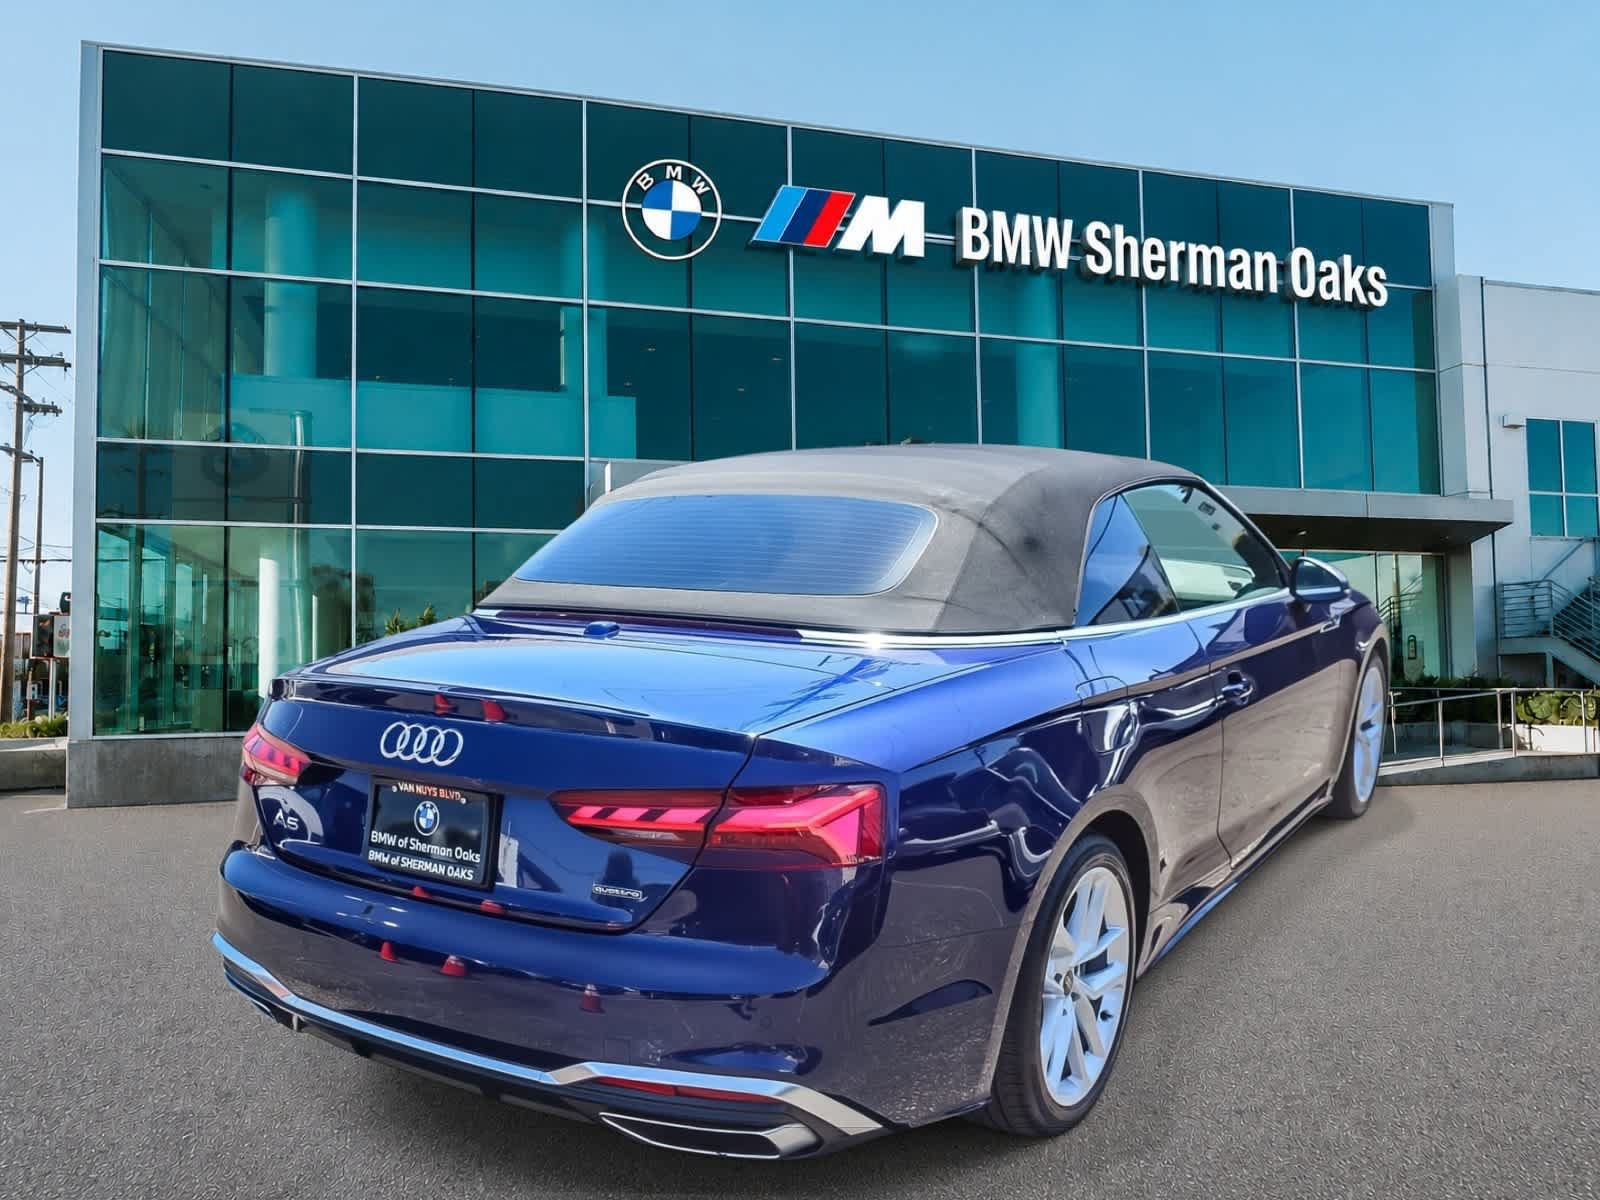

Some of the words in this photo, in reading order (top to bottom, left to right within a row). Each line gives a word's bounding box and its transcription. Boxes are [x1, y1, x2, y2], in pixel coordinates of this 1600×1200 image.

[636, 165, 711, 195] BMW
[836, 194, 925, 258] M
[959, 206, 1073, 269] BMW
[1084, 220, 1278, 294] Sherman
[1290, 247, 1388, 307] Oaks
[398, 782, 415, 793] VAN
[416, 784, 438, 797] NUYS
[439, 788, 461, 800] BLVD
[273, 808, 299, 830] A5
[370, 830, 397, 847] BMW
[398, 837, 409, 848] of
[409, 838, 452, 857] Sherman
[454, 846, 480, 863] Oaks
[368, 850, 391, 864] BMW
[391, 855, 400, 865] of
[400, 856, 445, 876] SHERMAN
[447, 866, 474, 881] OAKS
